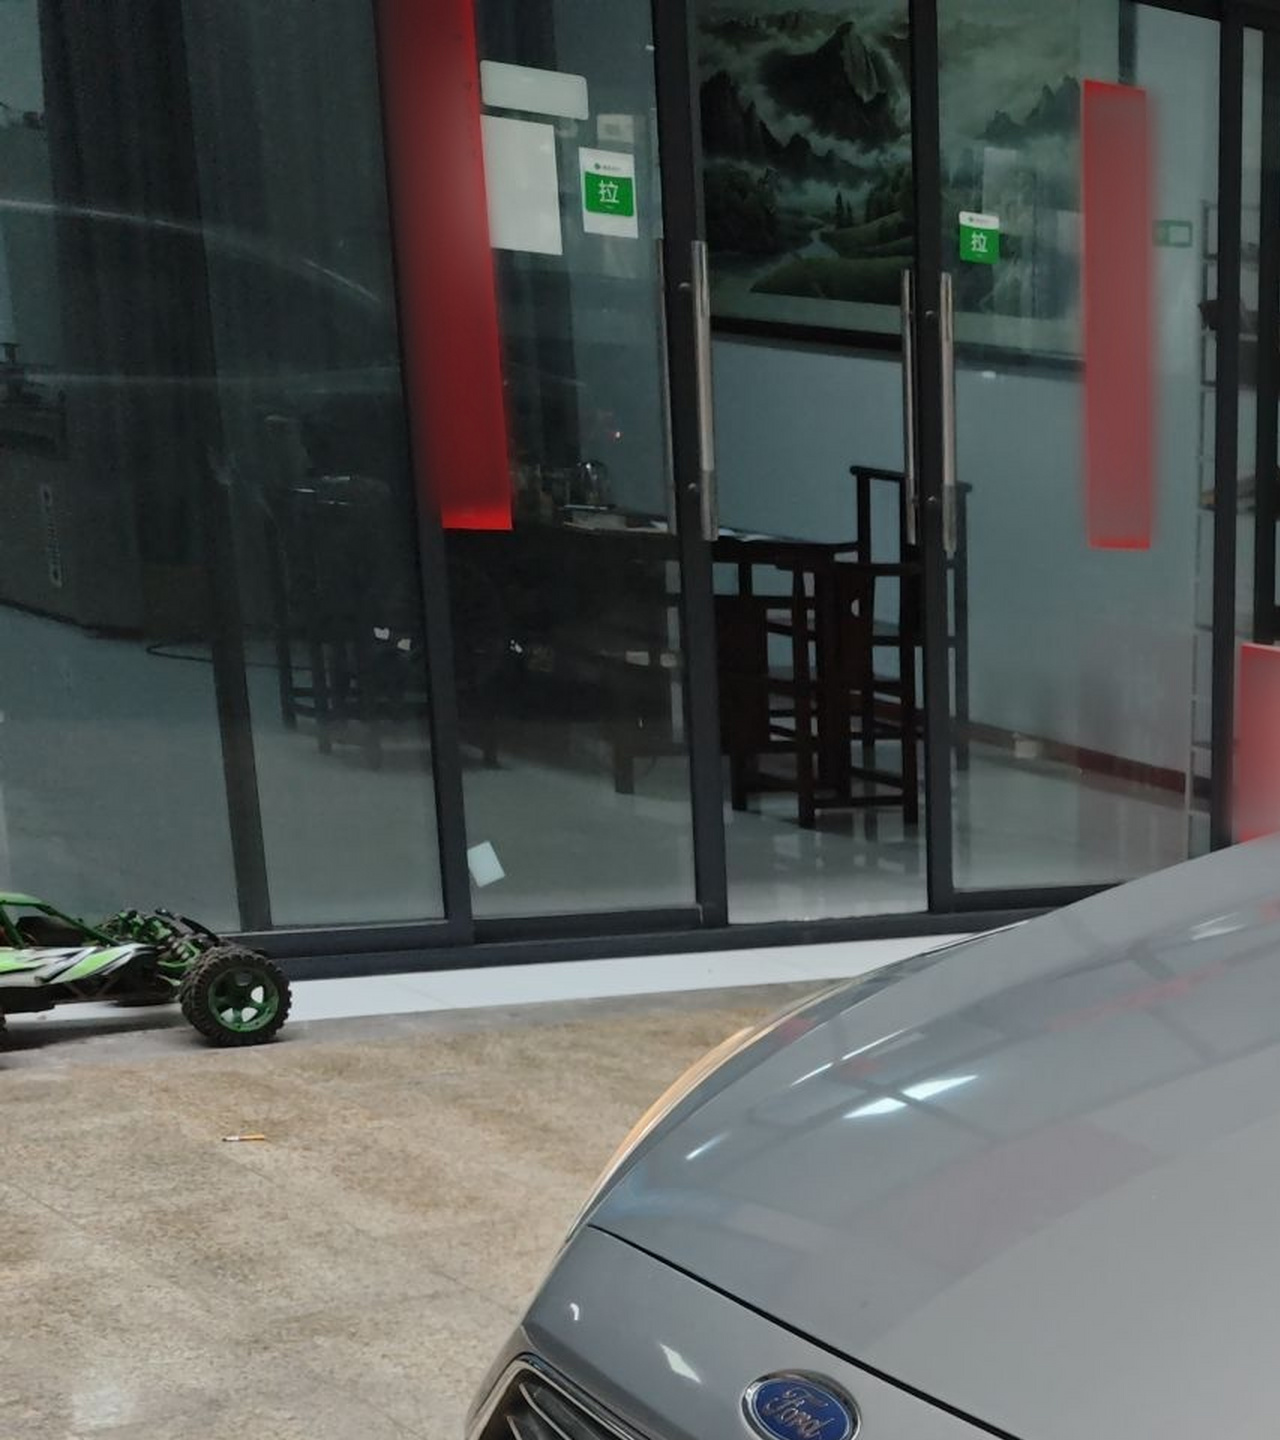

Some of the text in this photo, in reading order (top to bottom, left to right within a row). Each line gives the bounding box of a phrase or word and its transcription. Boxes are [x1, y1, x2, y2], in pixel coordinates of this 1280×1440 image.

[598, 179, 620, 204] 拉
[971, 231, 988, 253] 拉
[763, 1386, 835, 1440] Ford
